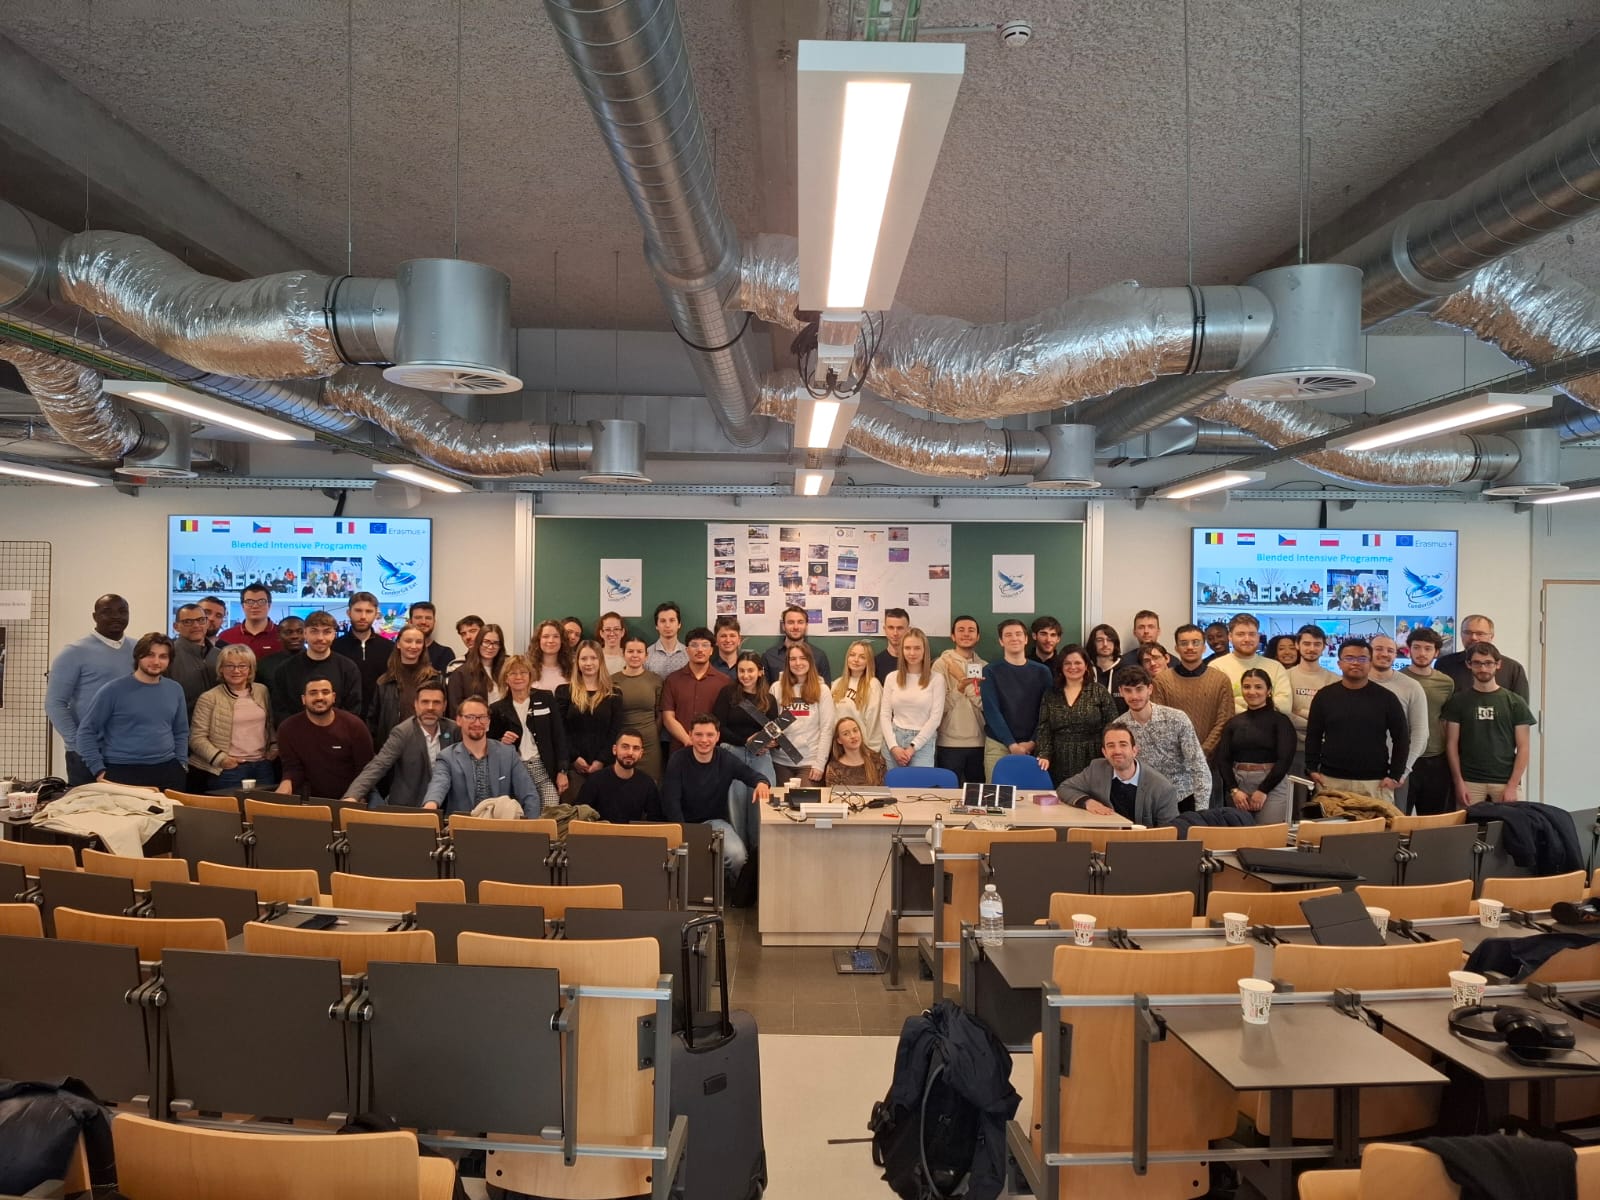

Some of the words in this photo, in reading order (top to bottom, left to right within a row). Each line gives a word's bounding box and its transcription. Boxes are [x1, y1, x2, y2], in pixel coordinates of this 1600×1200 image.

[388, 527, 426, 535] Erasmus+
[231, 540, 268, 549] Blended
[271, 541, 312, 550] Intensive
[314, 541, 368, 552] Programme
[1415, 539, 1454, 548] Erasmus+
[1256, 554, 1294, 563] Blended
[1296, 554, 1338, 564] Intensive
[1340, 555, 1394, 565] Programme
[1296, 688, 1317, 696] TOMM
